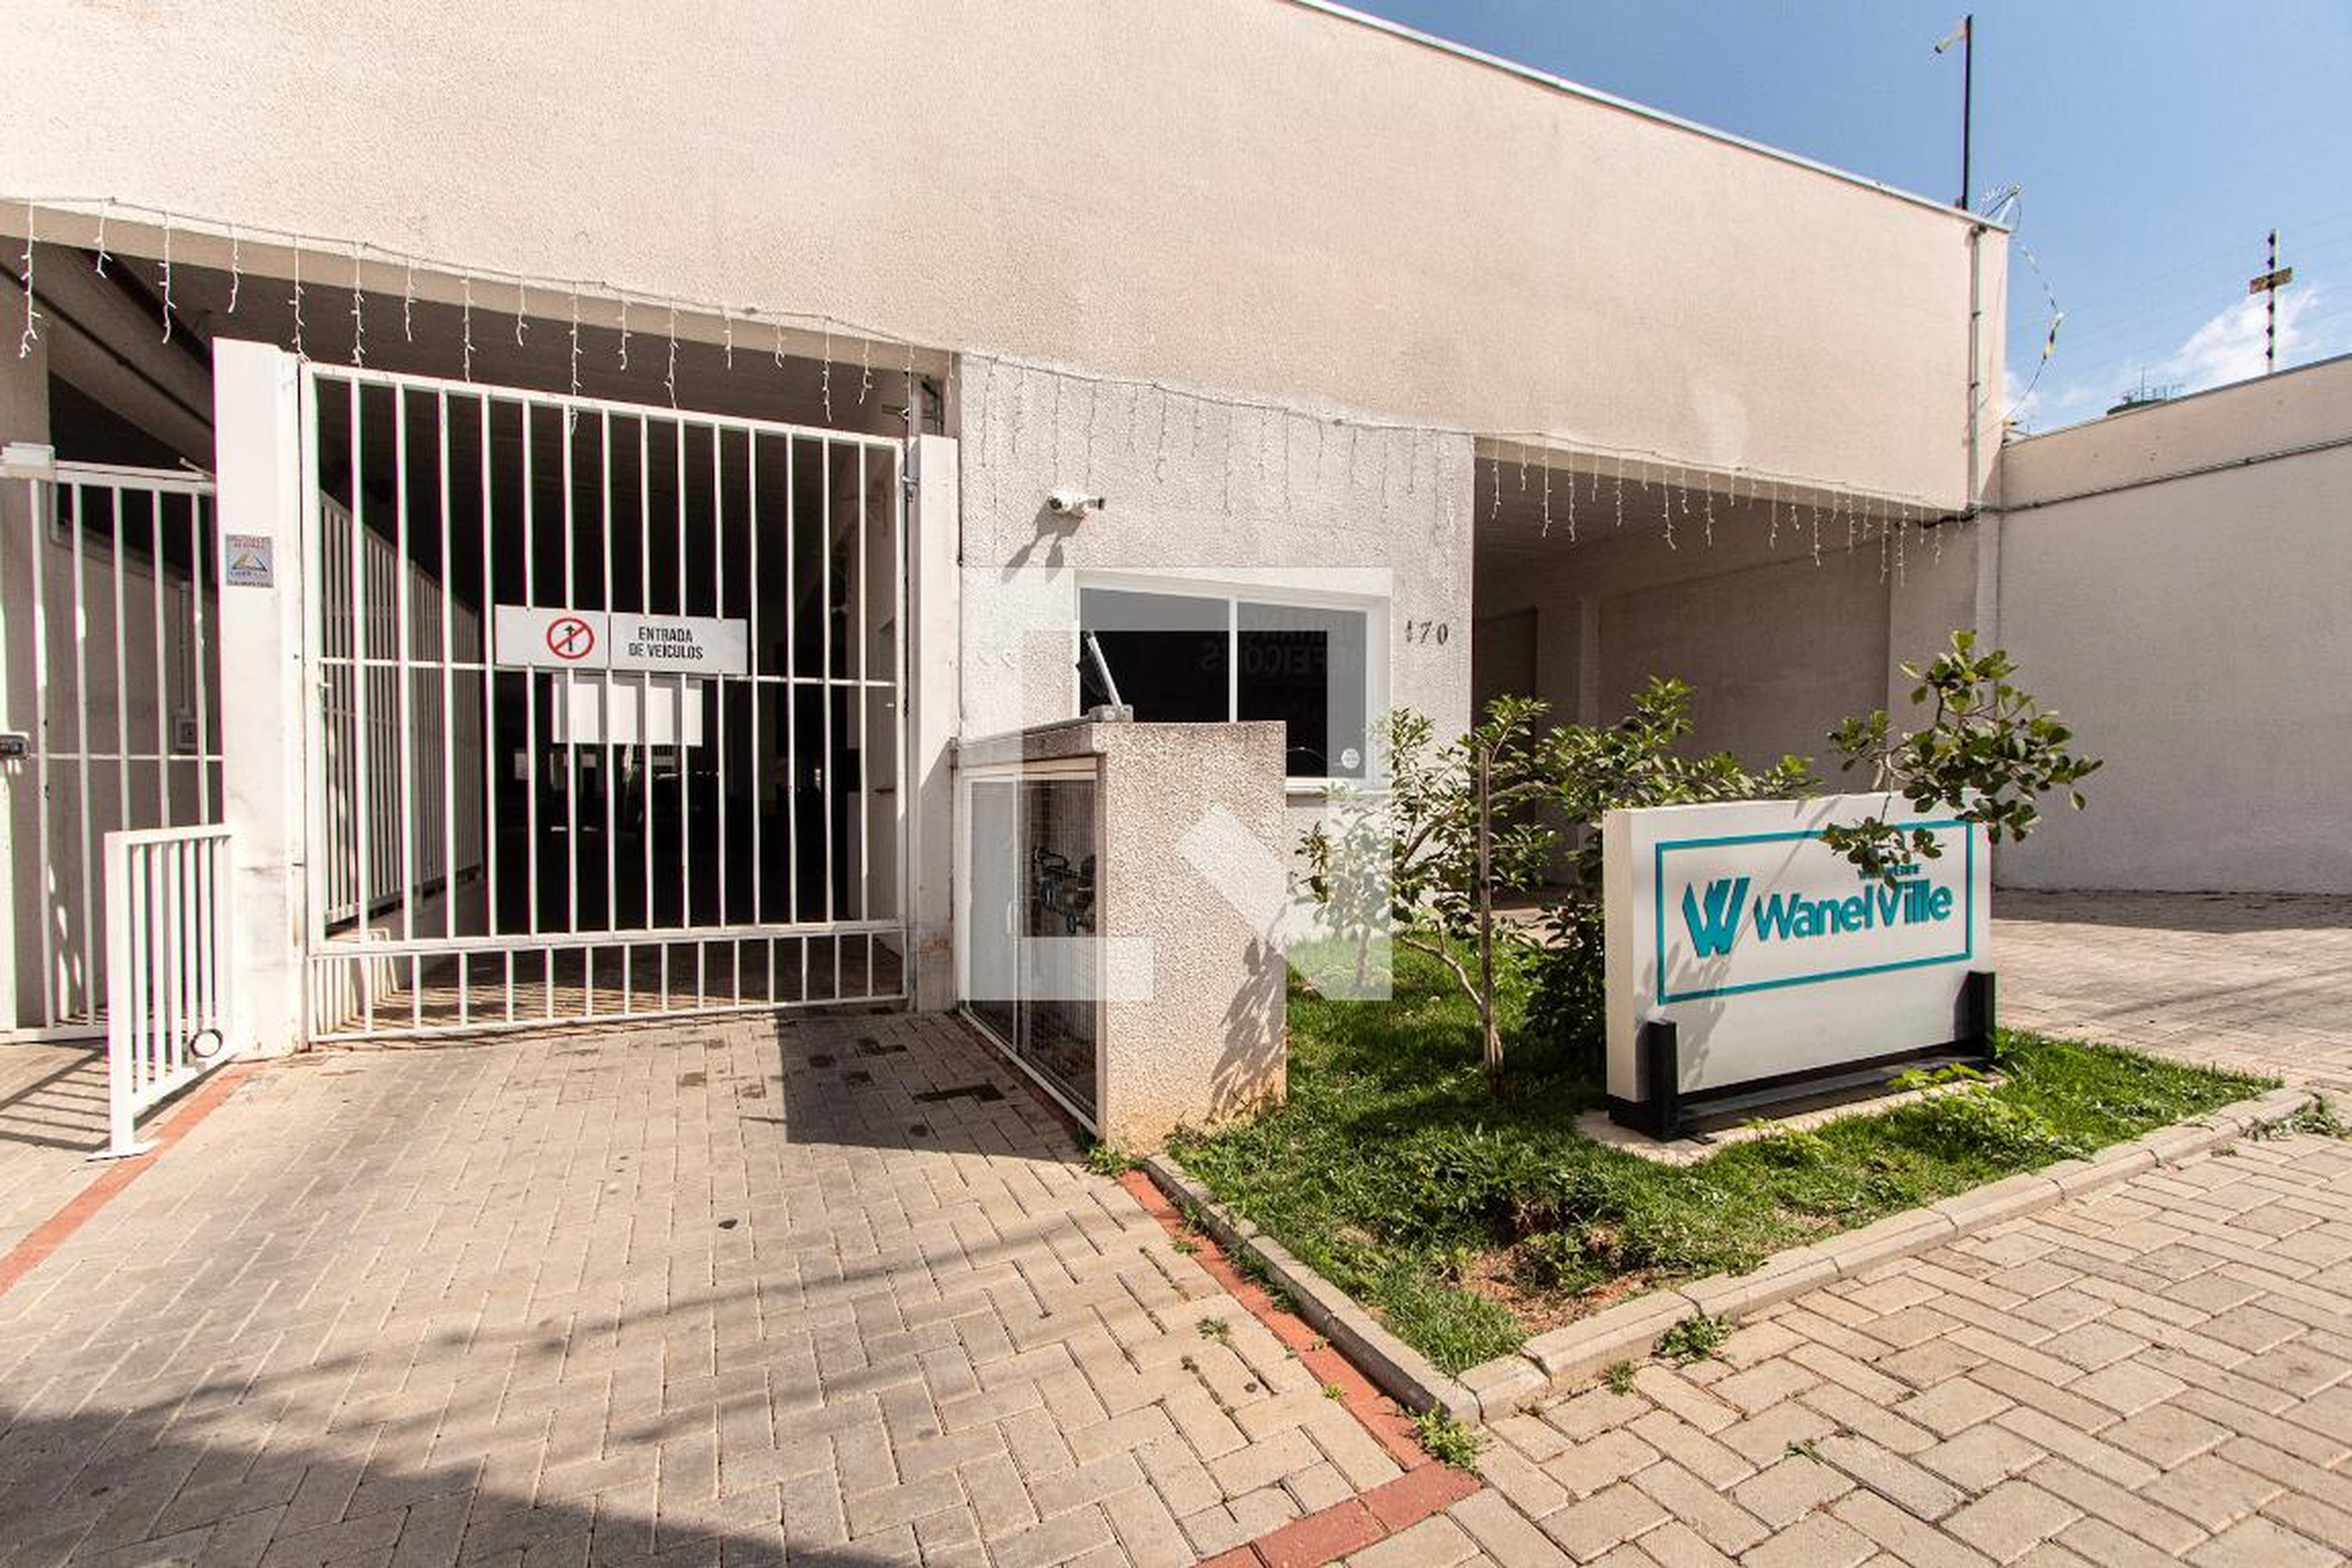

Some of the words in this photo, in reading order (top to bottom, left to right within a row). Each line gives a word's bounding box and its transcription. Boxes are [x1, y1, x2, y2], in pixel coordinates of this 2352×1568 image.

[638, 626, 693, 643] ENTRADA
[1405, 620, 1448, 646] 170
[628, 643, 644, 656] DE
[1754, 883, 1873, 941] Wanel
[1877, 880, 1952, 927] Ville
